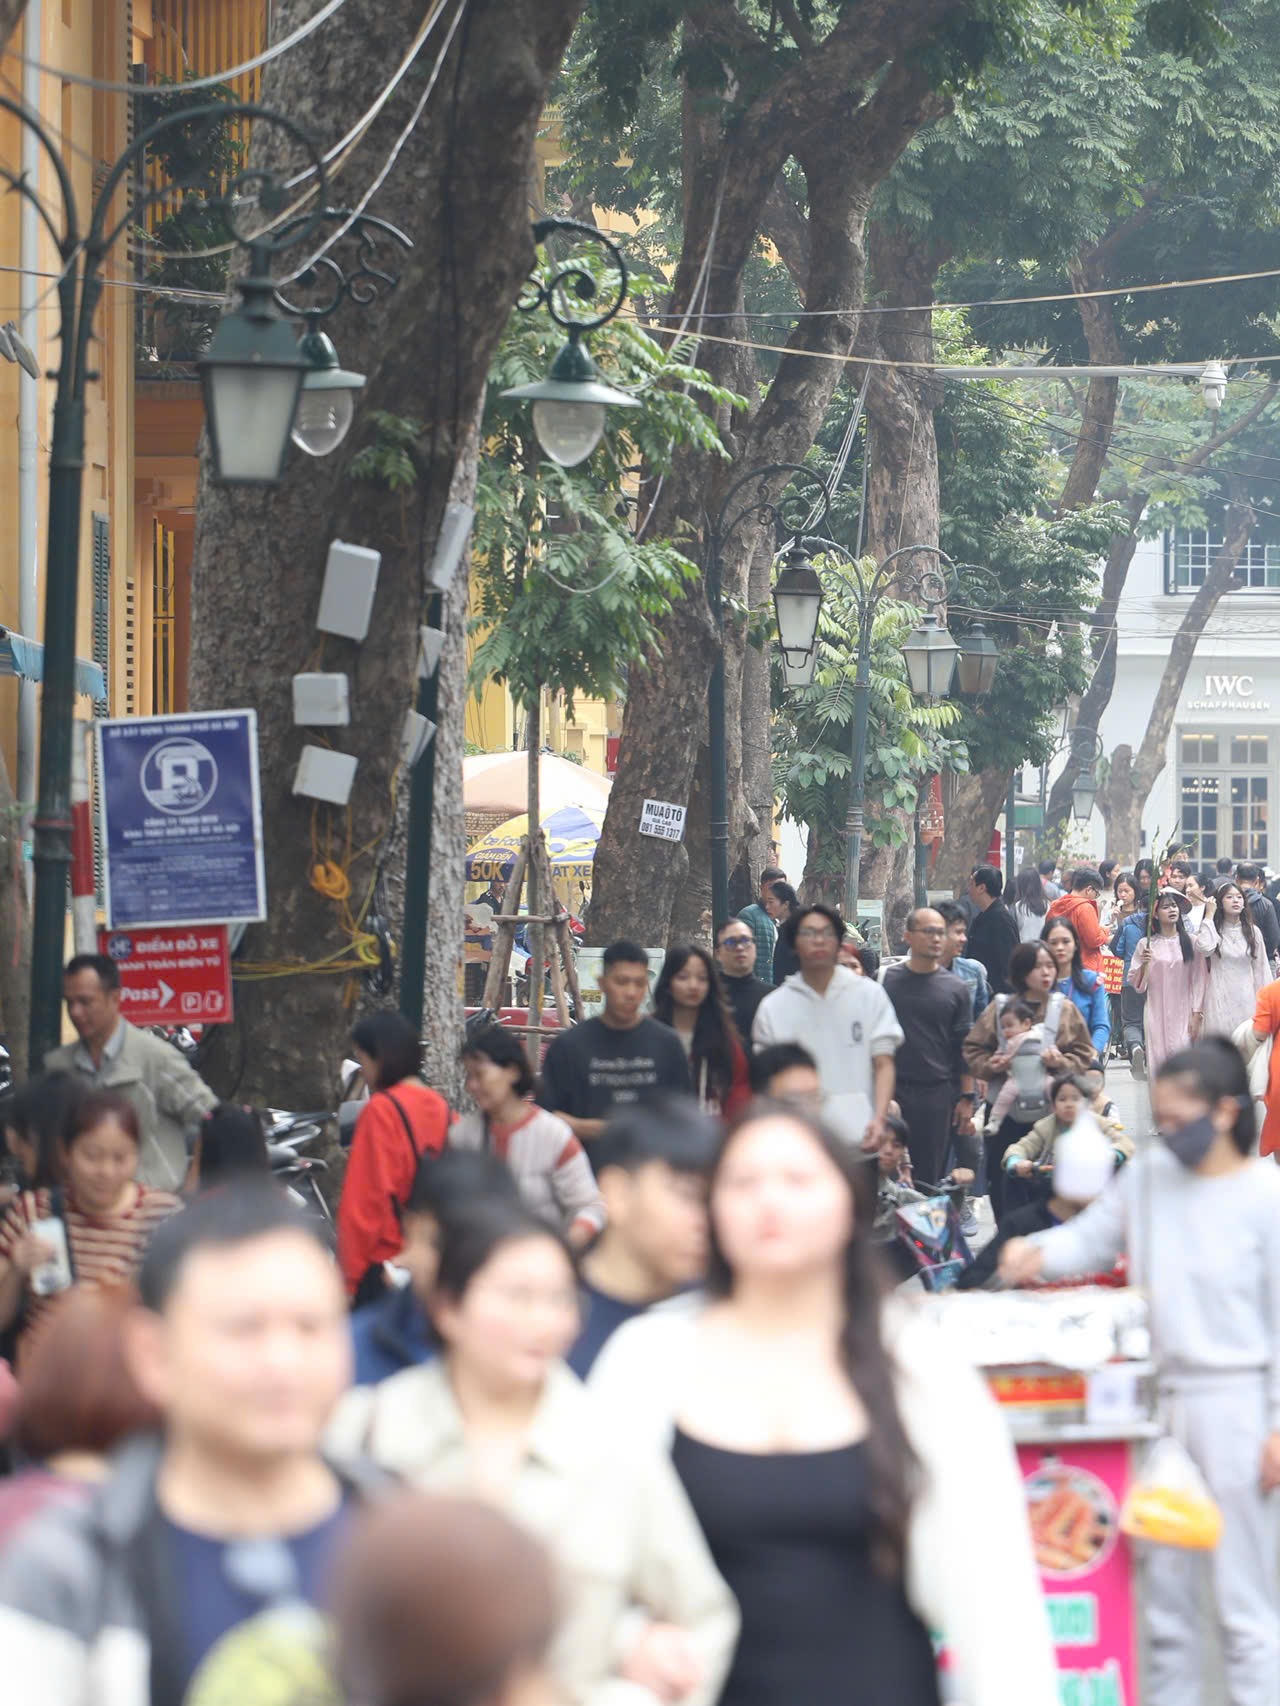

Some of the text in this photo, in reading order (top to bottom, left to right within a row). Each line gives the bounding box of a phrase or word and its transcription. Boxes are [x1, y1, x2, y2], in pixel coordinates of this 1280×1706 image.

[1205, 675, 1254, 697] IWC
[1187, 700, 1272, 710] SCHAFFHAUSEN
[470, 861, 505, 881] 50K
[572, 864, 592, 878] XE
[200, 937, 219, 950] XE
[120, 987, 160, 1002] Pass
